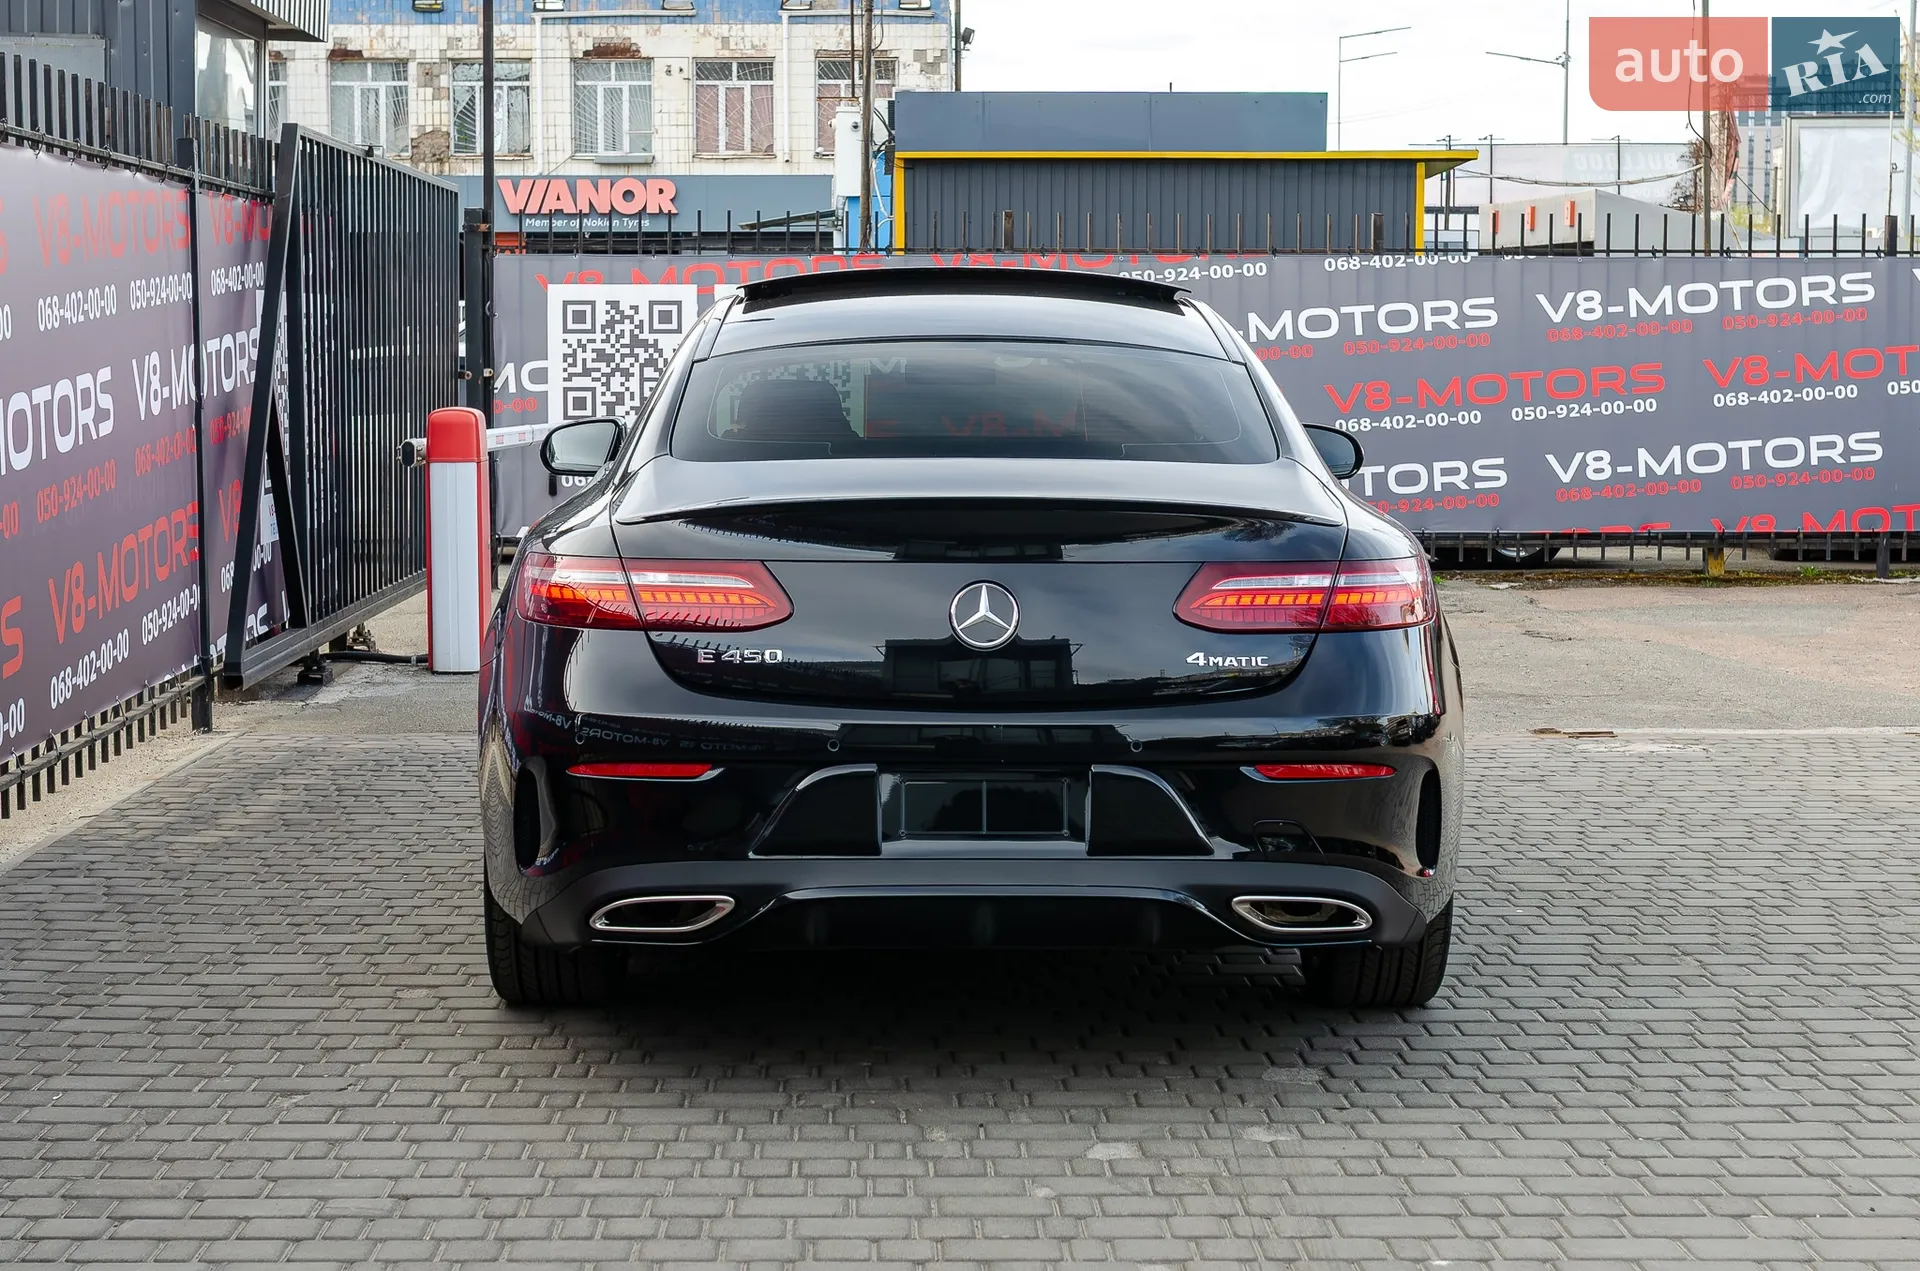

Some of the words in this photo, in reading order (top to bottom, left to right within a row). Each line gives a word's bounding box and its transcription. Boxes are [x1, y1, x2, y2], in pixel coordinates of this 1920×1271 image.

[497, 177, 678, 215] VIANOR
[33, 189, 190, 268] V8-MOTORS
[525, 217, 568, 227] Member
[582, 217, 620, 227] Nokin
[211, 261, 265, 297] 068-402-00-00
[1535, 271, 1875, 323] V8-MOTORS
[38, 283, 117, 332] 068-402-00-00
[1547, 318, 1693, 342] 068-402-00-00
[1722, 307, 1868, 331] 050-924-00-00
[1343, 332, 1491, 356] 050-924-00-00
[132, 326, 260, 421] V8-MOTORS
[1324, 362, 1666, 414] V8-MOTORS
[1713, 384, 1858, 407] 068-402-00-00
[0, 366, 115, 476] OTORS
[1335, 410, 1482, 432] 068-402-00-00
[1511, 397, 1657, 421] 050-924-00-00
[135, 427, 196, 477] 068-402-0-00
[1545, 431, 1884, 484] V8-MOTORS
[37, 458, 116, 524] 050-924-00-00
[1341, 457, 1508, 497] TORS
[1555, 478, 1702, 502] 068-402-00-00
[1730, 466, 1876, 490] 050-924-00-00
[48, 500, 198, 644] V8-MOTORS
[142, 583, 200, 646] 050-924-00-0
[50, 628, 129, 710] 068-402-00-00
[697, 649, 716, 664] E
[721, 649, 783, 664] 450
[1186, 652, 1268, 667] 4MATIC
